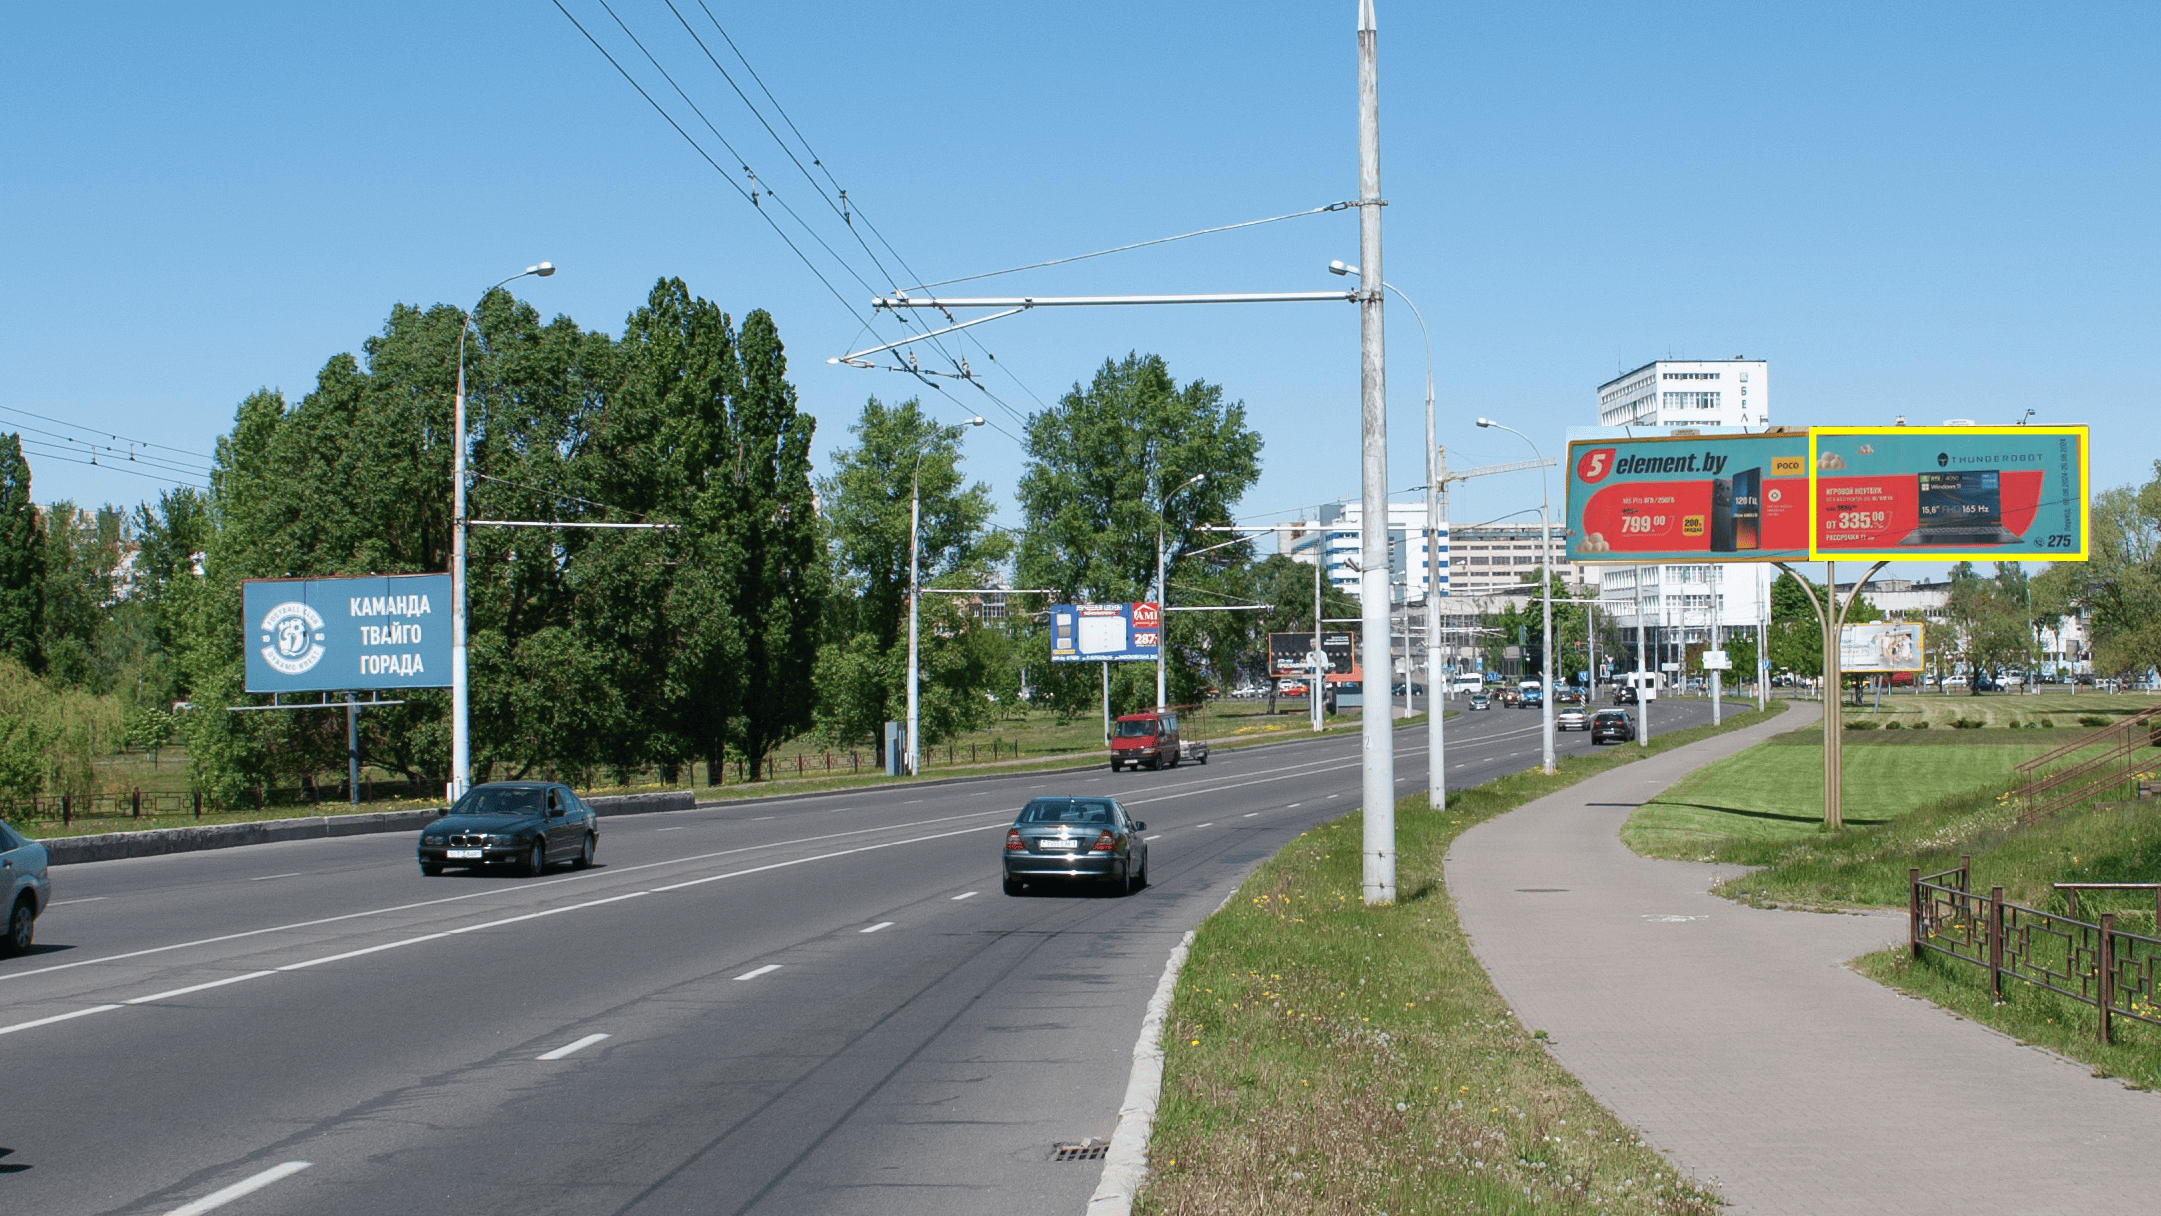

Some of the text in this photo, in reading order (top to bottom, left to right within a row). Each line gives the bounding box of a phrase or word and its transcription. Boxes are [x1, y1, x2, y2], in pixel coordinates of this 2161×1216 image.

[1586, 452, 1729, 477] 5 element.by
[1777, 461, 1799, 470] POCO
[1952, 453, 2044, 465] THUNDEROBOT
[1735, 496, 1748, 505] 120
[1962, 505, 1977, 513] 165
[1978, 505, 1990, 513] Hz
[2047, 533, 2072, 548] 275
[350, 594, 431, 618] КАМАНДА
[1133, 611, 1158, 620] AMI
[360, 621, 422, 646] ТВАЙГО
[359, 653, 424, 676] ГОРАДА
